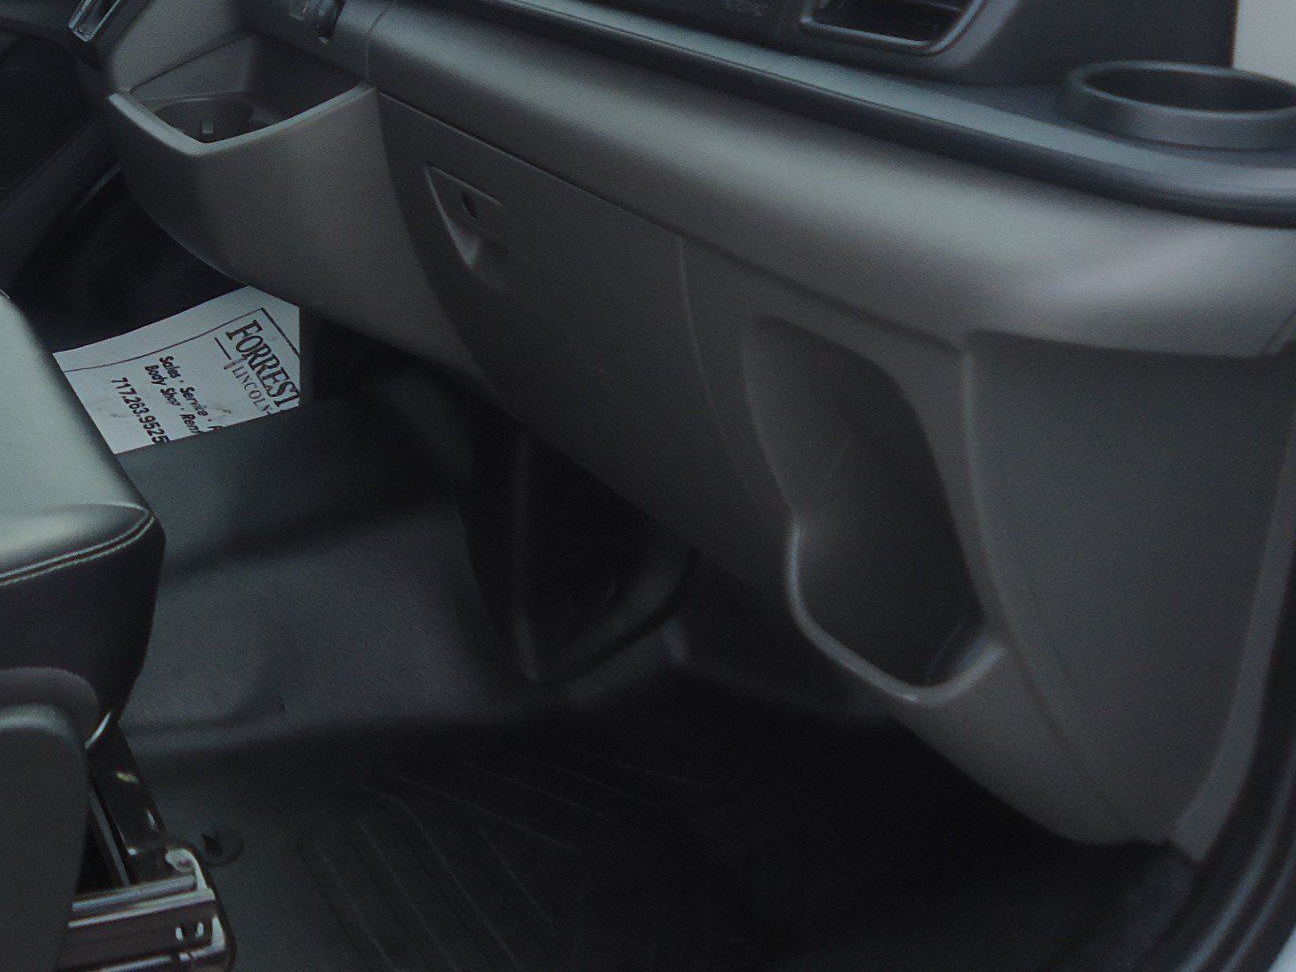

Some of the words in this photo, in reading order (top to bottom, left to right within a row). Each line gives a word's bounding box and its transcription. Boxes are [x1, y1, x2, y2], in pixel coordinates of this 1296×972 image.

[144, 364, 168, 385] Body
[159, 355, 181, 378] Sales
[225, 319, 300, 408] FORREST
[110, 377, 170, 444] 717.263.9525
